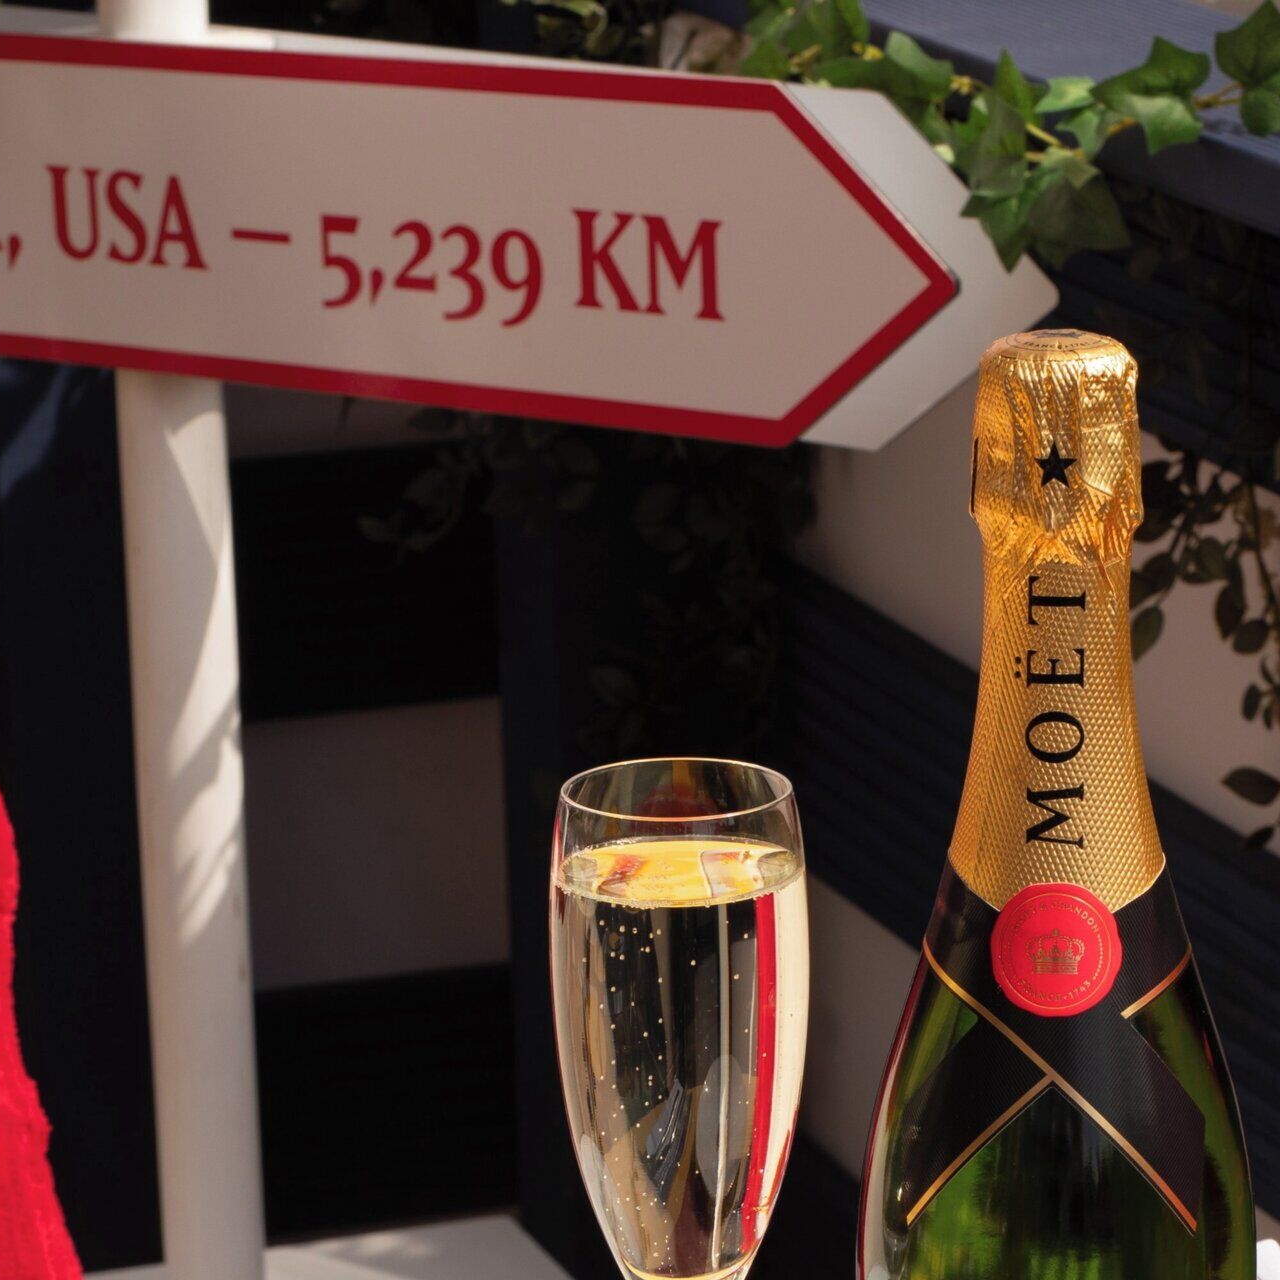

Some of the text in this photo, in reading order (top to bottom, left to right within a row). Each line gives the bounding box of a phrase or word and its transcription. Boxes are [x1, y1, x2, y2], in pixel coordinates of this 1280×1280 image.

[44, 165, 210, 271] USA
[320, 212, 543, 327] 5,239
[570, 207, 726, 322] KM
[1013, 575, 1087, 849] MOËT
